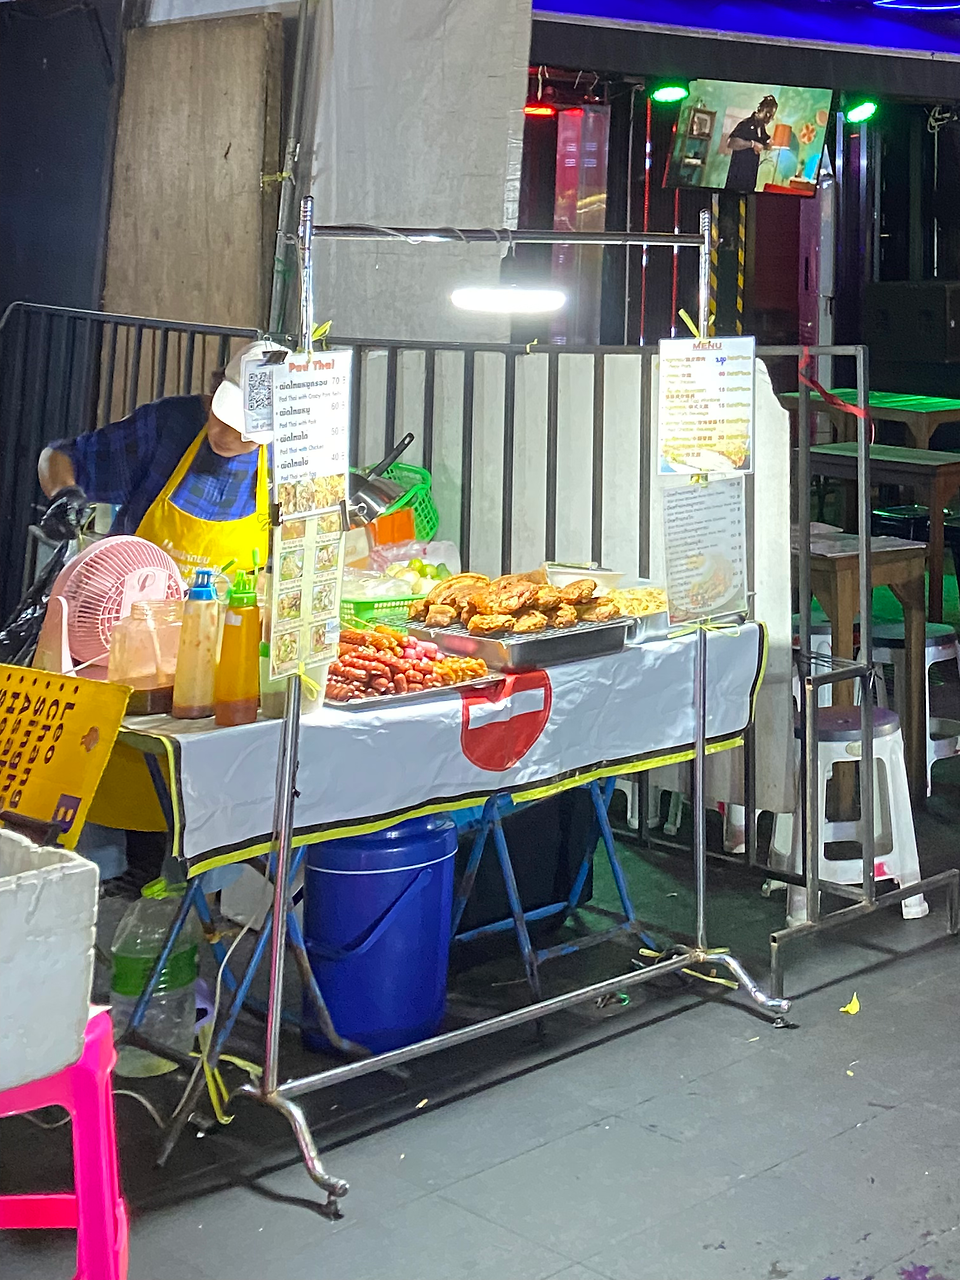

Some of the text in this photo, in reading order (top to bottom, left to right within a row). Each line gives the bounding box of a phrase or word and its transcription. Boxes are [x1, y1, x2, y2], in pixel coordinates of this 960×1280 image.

[692, 342, 722, 350] MENU
[288, 359, 335, 373] Pad Thai
[331, 376, 340, 385] 70
[44, 701, 76, 765] Leo
[9, 699, 59, 809] Chang
